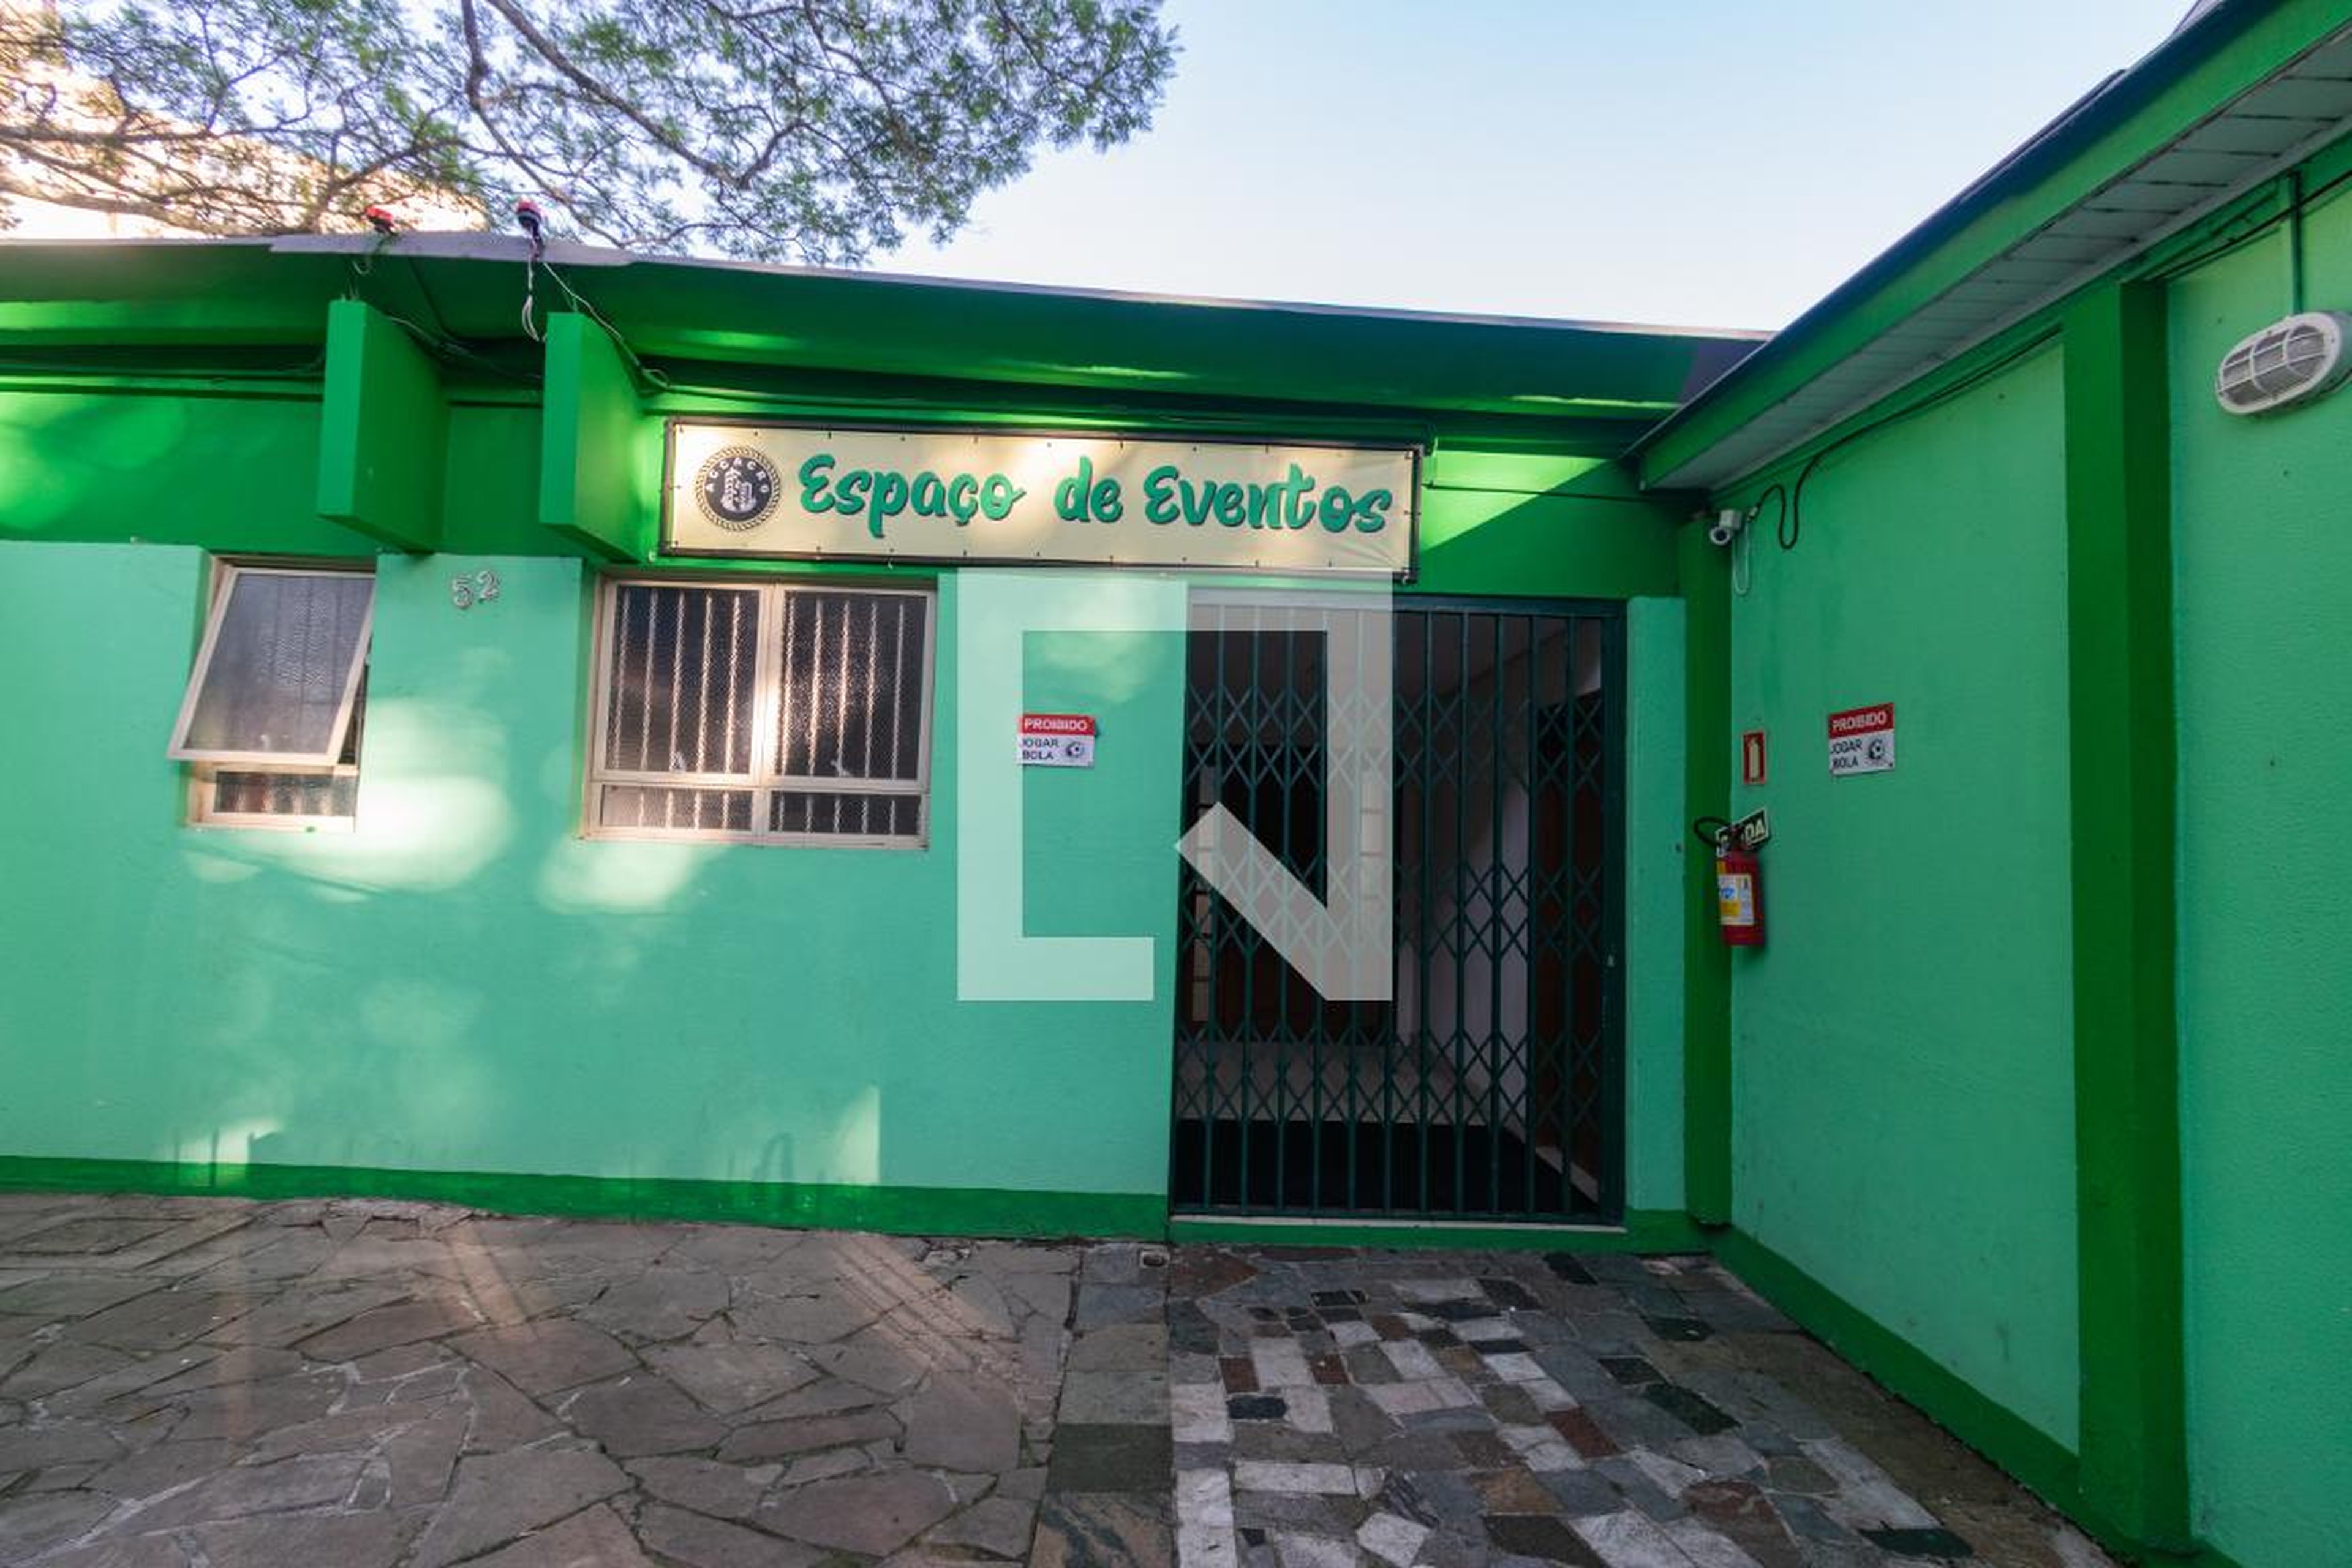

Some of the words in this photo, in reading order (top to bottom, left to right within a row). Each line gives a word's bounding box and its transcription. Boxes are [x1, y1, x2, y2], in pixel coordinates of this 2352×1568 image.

[799, 454, 1027, 538] Espaço
[1054, 456, 1123, 522] de
[1143, 463, 1393, 533] Eventos
[453, 571, 500, 609] 52
[1024, 718, 1088, 731] PROIBIDO
[1832, 710, 1888, 732] PROIBIDO
[1830, 739, 1863, 754] JOGAR
[1022, 750, 1054, 760] BOLA
[1833, 756, 1858, 768] BOLA
